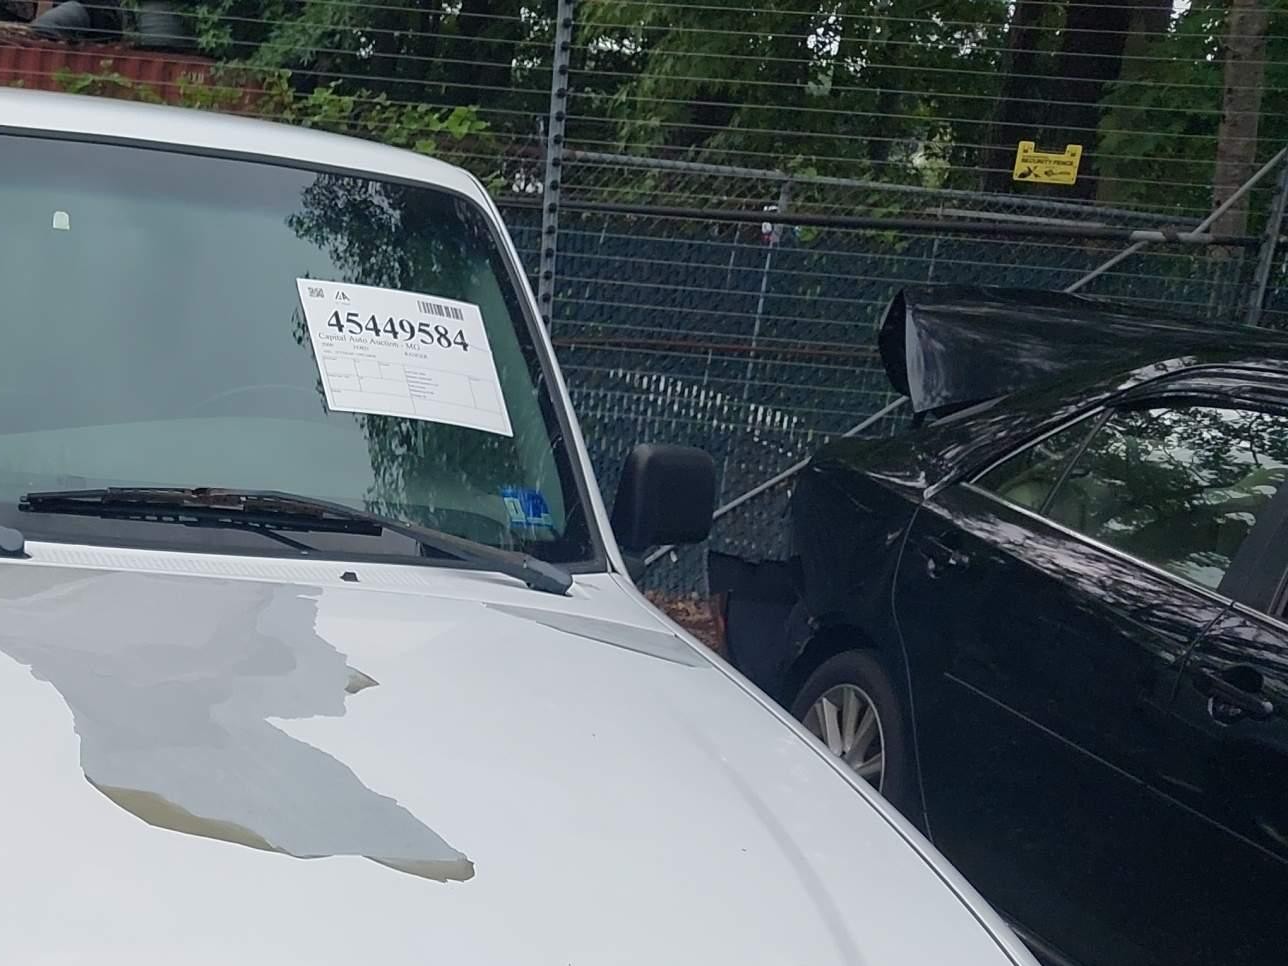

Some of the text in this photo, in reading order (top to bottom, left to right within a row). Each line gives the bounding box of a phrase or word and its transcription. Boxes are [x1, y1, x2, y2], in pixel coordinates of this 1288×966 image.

[318, 332, 347, 342] Capital
[349, 335, 368, 344] Auto
[369, 337, 399, 348] Auction
[327, 310, 469, 351] 45449584
